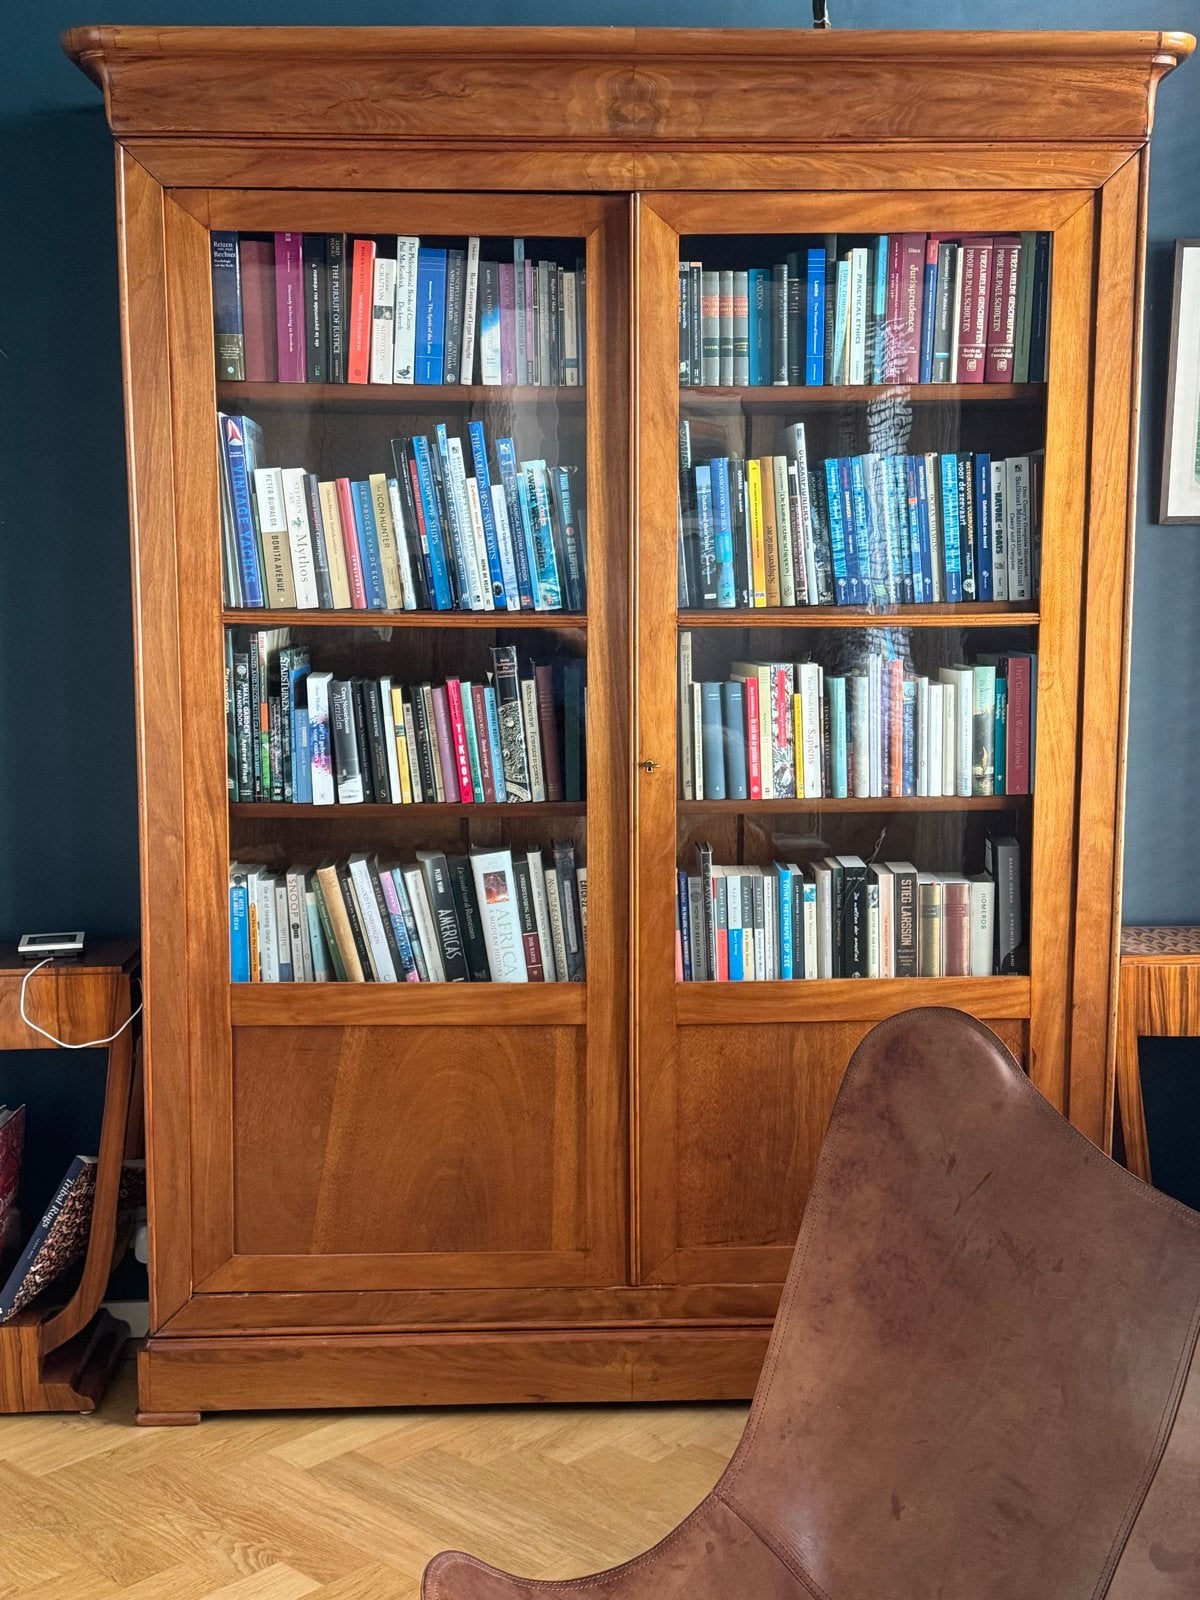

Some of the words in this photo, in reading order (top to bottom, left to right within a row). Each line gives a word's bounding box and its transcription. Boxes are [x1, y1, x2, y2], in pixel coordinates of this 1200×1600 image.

[979, 249, 987, 295] VERZAMELDE
[1009, 249, 1018, 295] VERZAMELDE
[908, 264, 919, 333] Jurisprudence
[333, 314, 339, 323] OF
[976, 296, 985, 344] GESCHRIFTEN
[1006, 296, 1018, 344] GESCHRIFTEN
[419, 440, 427, 458] THE
[233, 465, 249, 523] VINTAGE
[265, 474, 274, 494] PETER
[359, 485, 367, 501] HET
[420, 461, 433, 501] HISTORY
[526, 468, 537, 502] zwaar
[560, 473, 568, 489] THOR
[959, 482, 965, 492] de
[268, 497, 277, 527] BUWALDA
[294, 482, 302, 514] STEPHEN
[377, 494, 386, 514] ICON
[428, 504, 434, 516] OF
[562, 491, 572, 525] HEYERDAHL
[362, 504, 372, 536] PROCES
[379, 516, 390, 548] HUNTER
[430, 518, 439, 544] SHIPS
[531, 506, 543, 532] weer
[240, 530, 255, 583] YACHTS
[271, 535, 280, 562] BONITA
[294, 534, 308, 583] Mythos
[369, 558, 376, 567] DE
[535, 536, 546, 569] zeilen
[274, 564, 284, 592] AVENUE
[371, 570, 380, 592] EEUW
[569, 554, 579, 579] EXPEDITIE
[281, 657, 290, 711] STADSTUINEN
[1015, 682, 1023, 717] Cultureel
[333, 692, 343, 730] Allerzielen
[342, 700, 350, 734] Nooteboom
[456, 724, 469, 786] TIKKOP
[804, 729, 816, 765] Sapiens
[1015, 720, 1023, 769] Woordenboek
[288, 879, 298, 918] SNOOP
[520, 874, 529, 913] UNDERSTANDING
[901, 879, 912, 903] STIEG
[374, 888, 382, 902] STAD
[382, 918, 394, 948] GRACHTEN
[438, 909, 462, 959] AMERICAS
[694, 921, 700, 930] TO
[901, 906, 912, 946] LARSSON
[496, 909, 517, 976] AFRICA
[784, 943, 789, 952] OP
[493, 948, 503, 978] HISTORY
[54, 1178, 75, 1206] Tribal
[42, 1206, 59, 1229] Rugs
